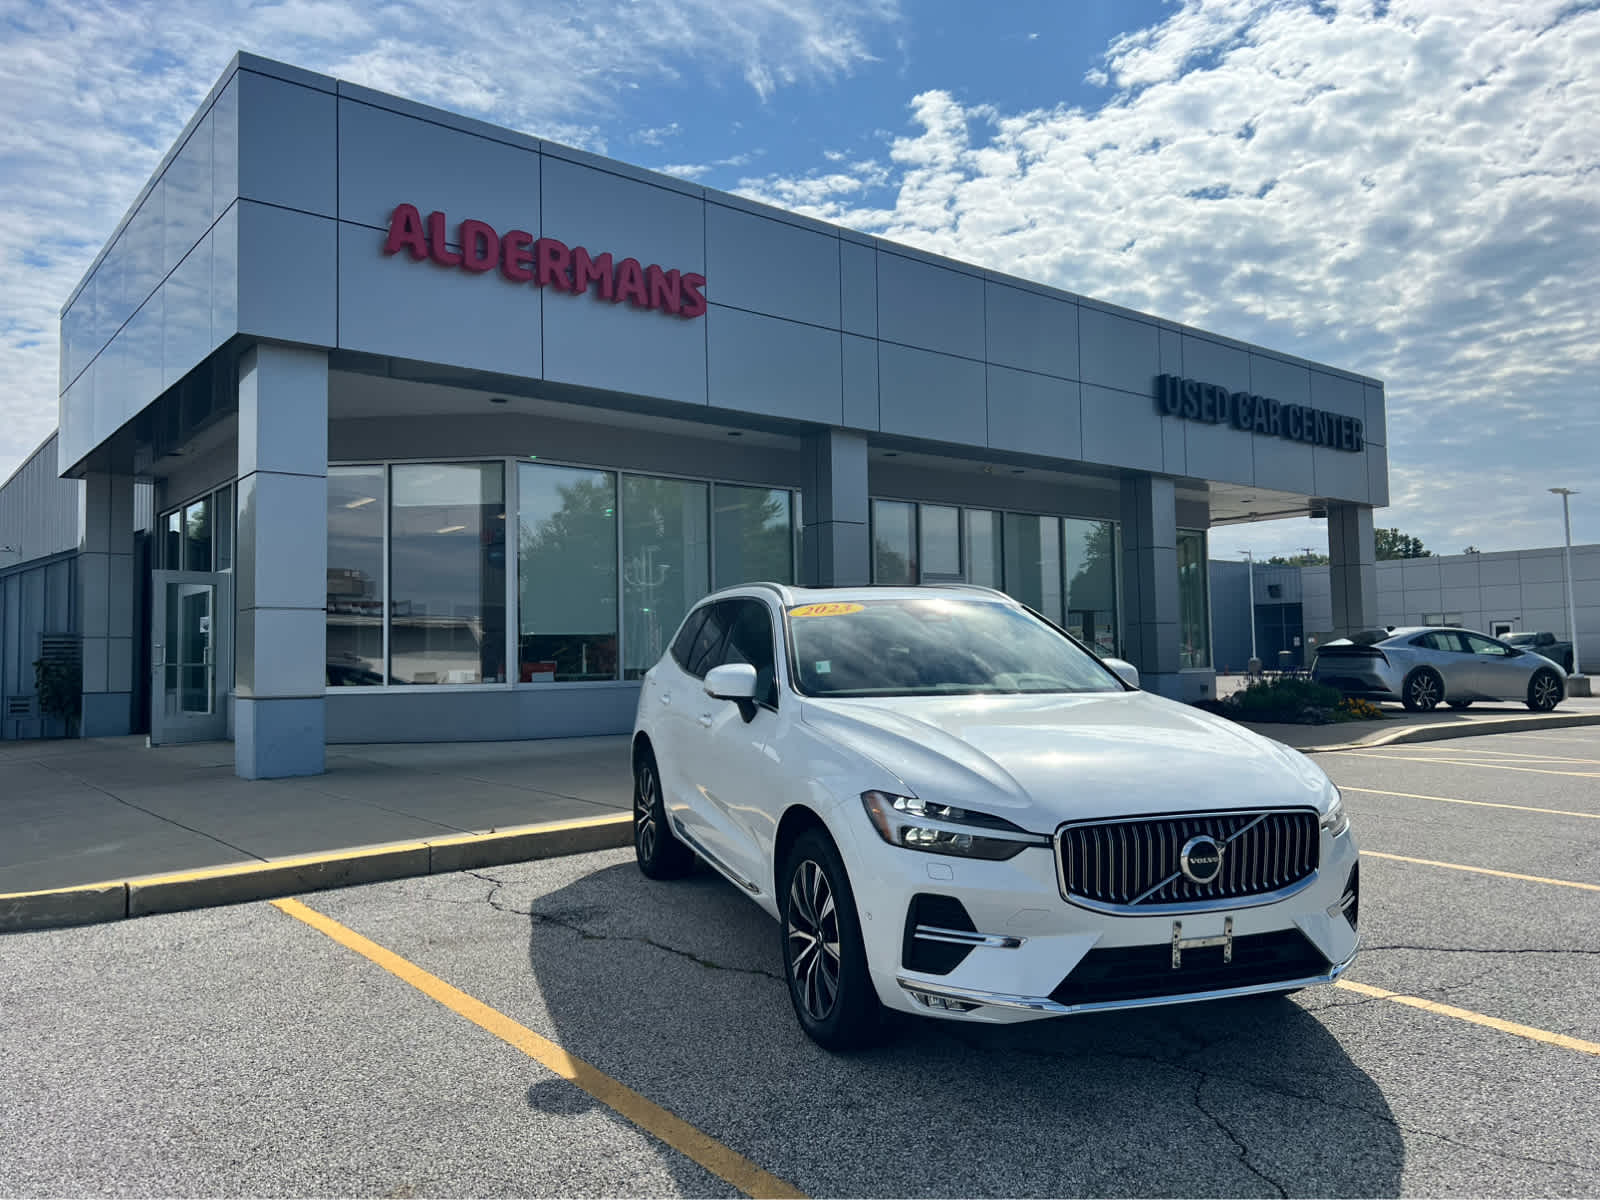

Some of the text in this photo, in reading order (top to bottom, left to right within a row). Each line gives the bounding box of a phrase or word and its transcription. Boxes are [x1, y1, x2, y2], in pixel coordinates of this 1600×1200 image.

[384, 203, 707, 318] ALDERMANS
[1156, 375, 1363, 452] USED CAR CENTER
